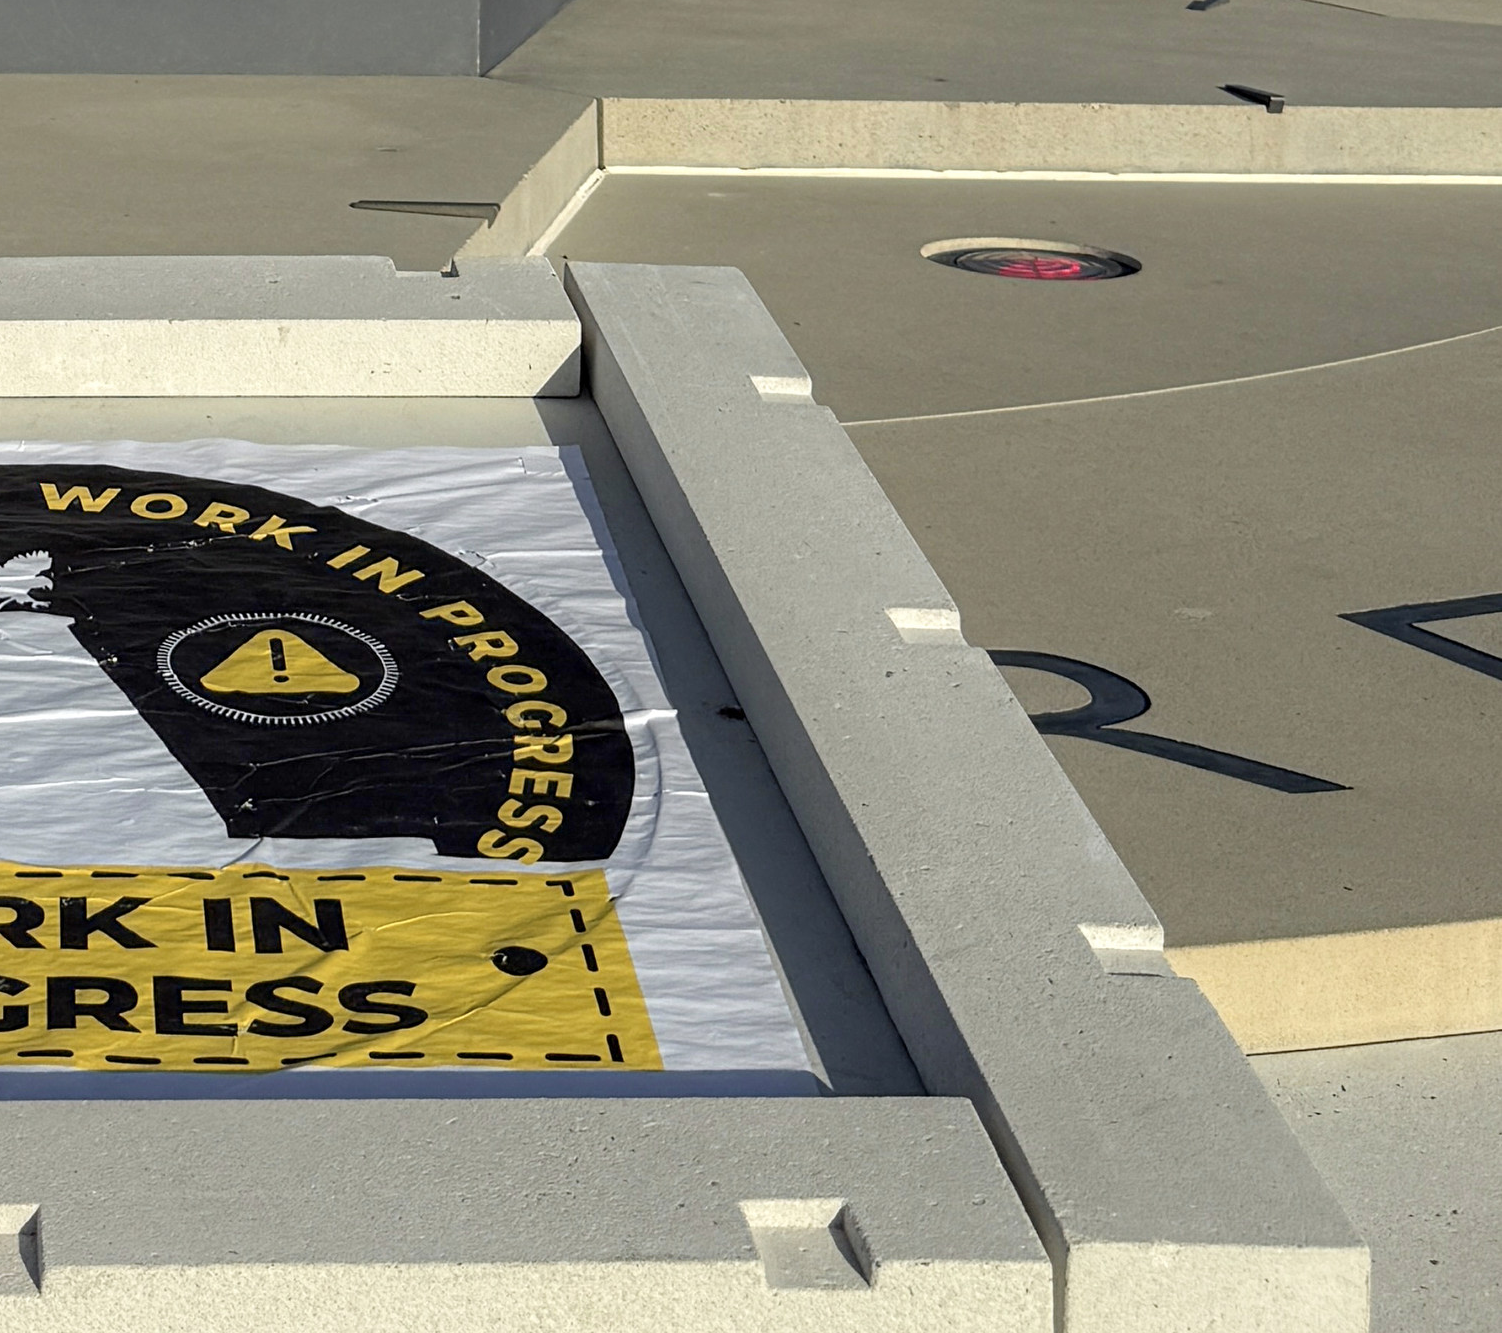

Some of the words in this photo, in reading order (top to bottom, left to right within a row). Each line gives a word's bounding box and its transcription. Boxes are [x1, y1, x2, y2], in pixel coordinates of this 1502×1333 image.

[40, 484, 316, 552] WORK
[326, 544, 426, 594] IN
[418, 600, 575, 866] PROGRESS
[201, 896, 351, 955] IN
